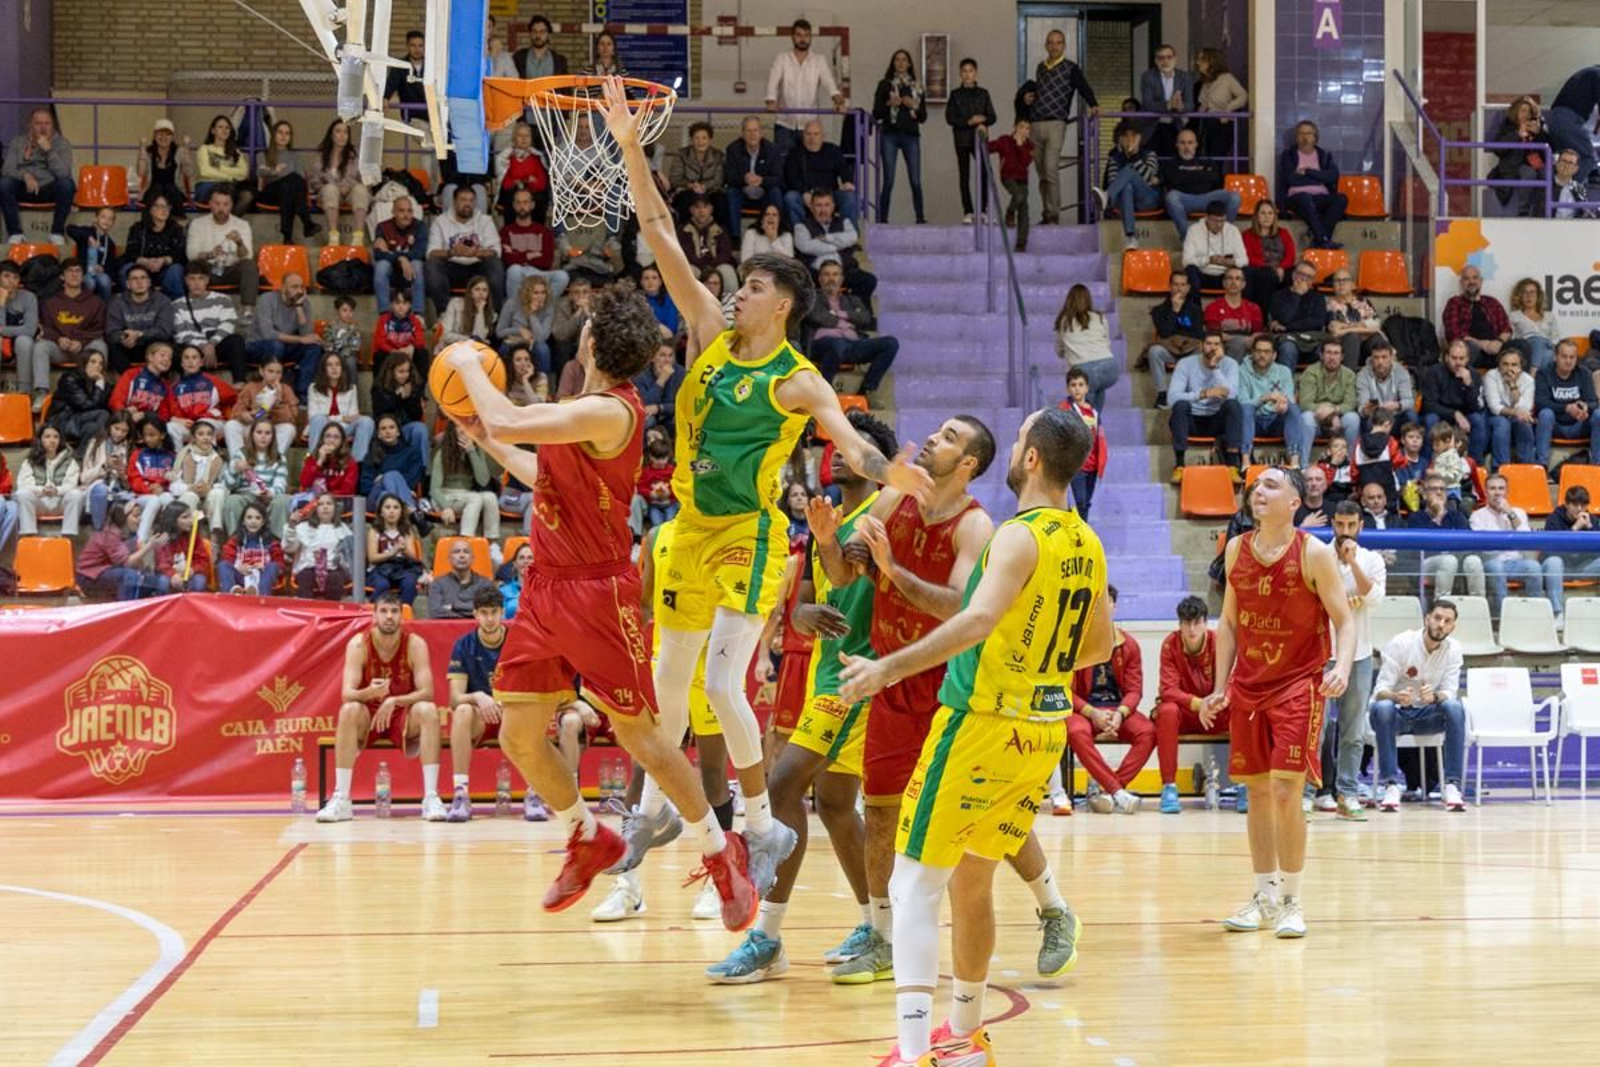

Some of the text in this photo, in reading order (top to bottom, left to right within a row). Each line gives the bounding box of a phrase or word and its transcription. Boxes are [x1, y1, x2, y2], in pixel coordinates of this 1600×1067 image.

[1315, 7, 1339, 40] A
[1551, 385, 1581, 400] VANS
[1258, 575, 1274, 596] 16
[1037, 587, 1092, 673] 13
[221, 716, 337, 737] CAJA RURAL
[255, 734, 304, 756] JAÉN
[1288, 744, 1302, 759] 16
